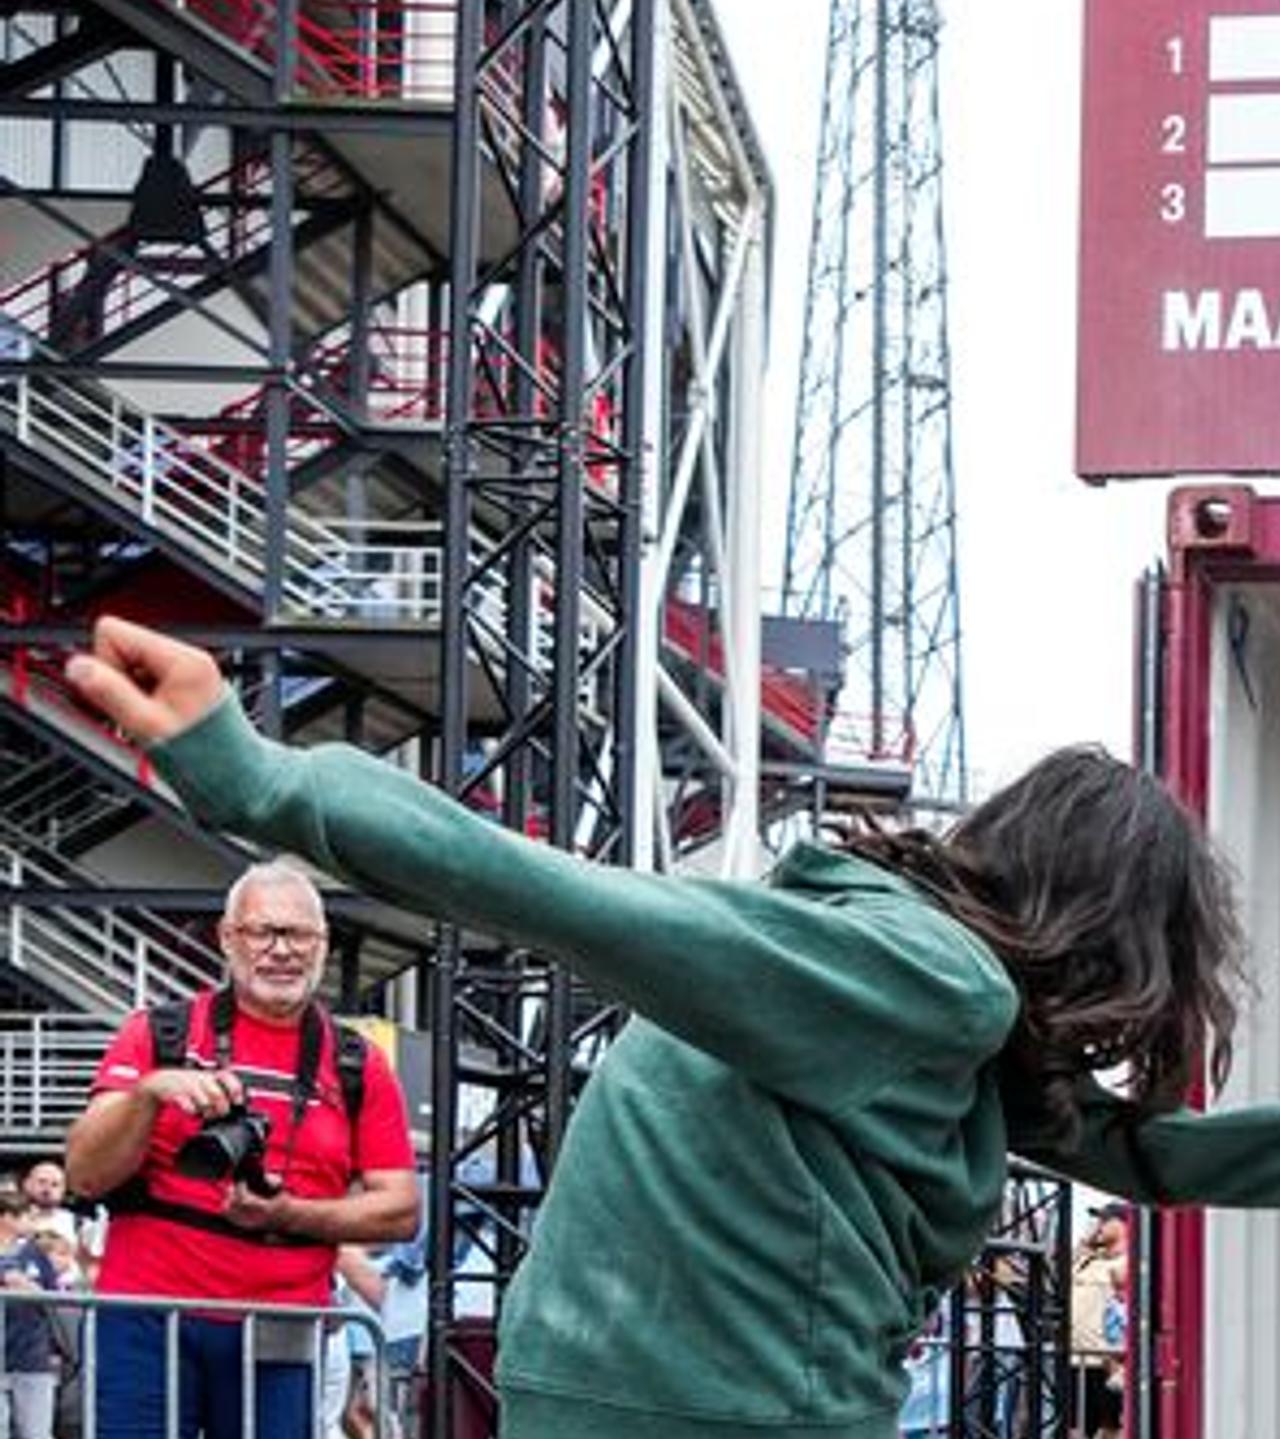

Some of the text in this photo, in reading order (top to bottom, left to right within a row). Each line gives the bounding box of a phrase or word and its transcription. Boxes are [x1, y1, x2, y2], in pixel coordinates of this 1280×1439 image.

[1167, 37, 1182, 74] 1
[1162, 114, 1186, 153] 2
[1161, 183, 1185, 223] 3
